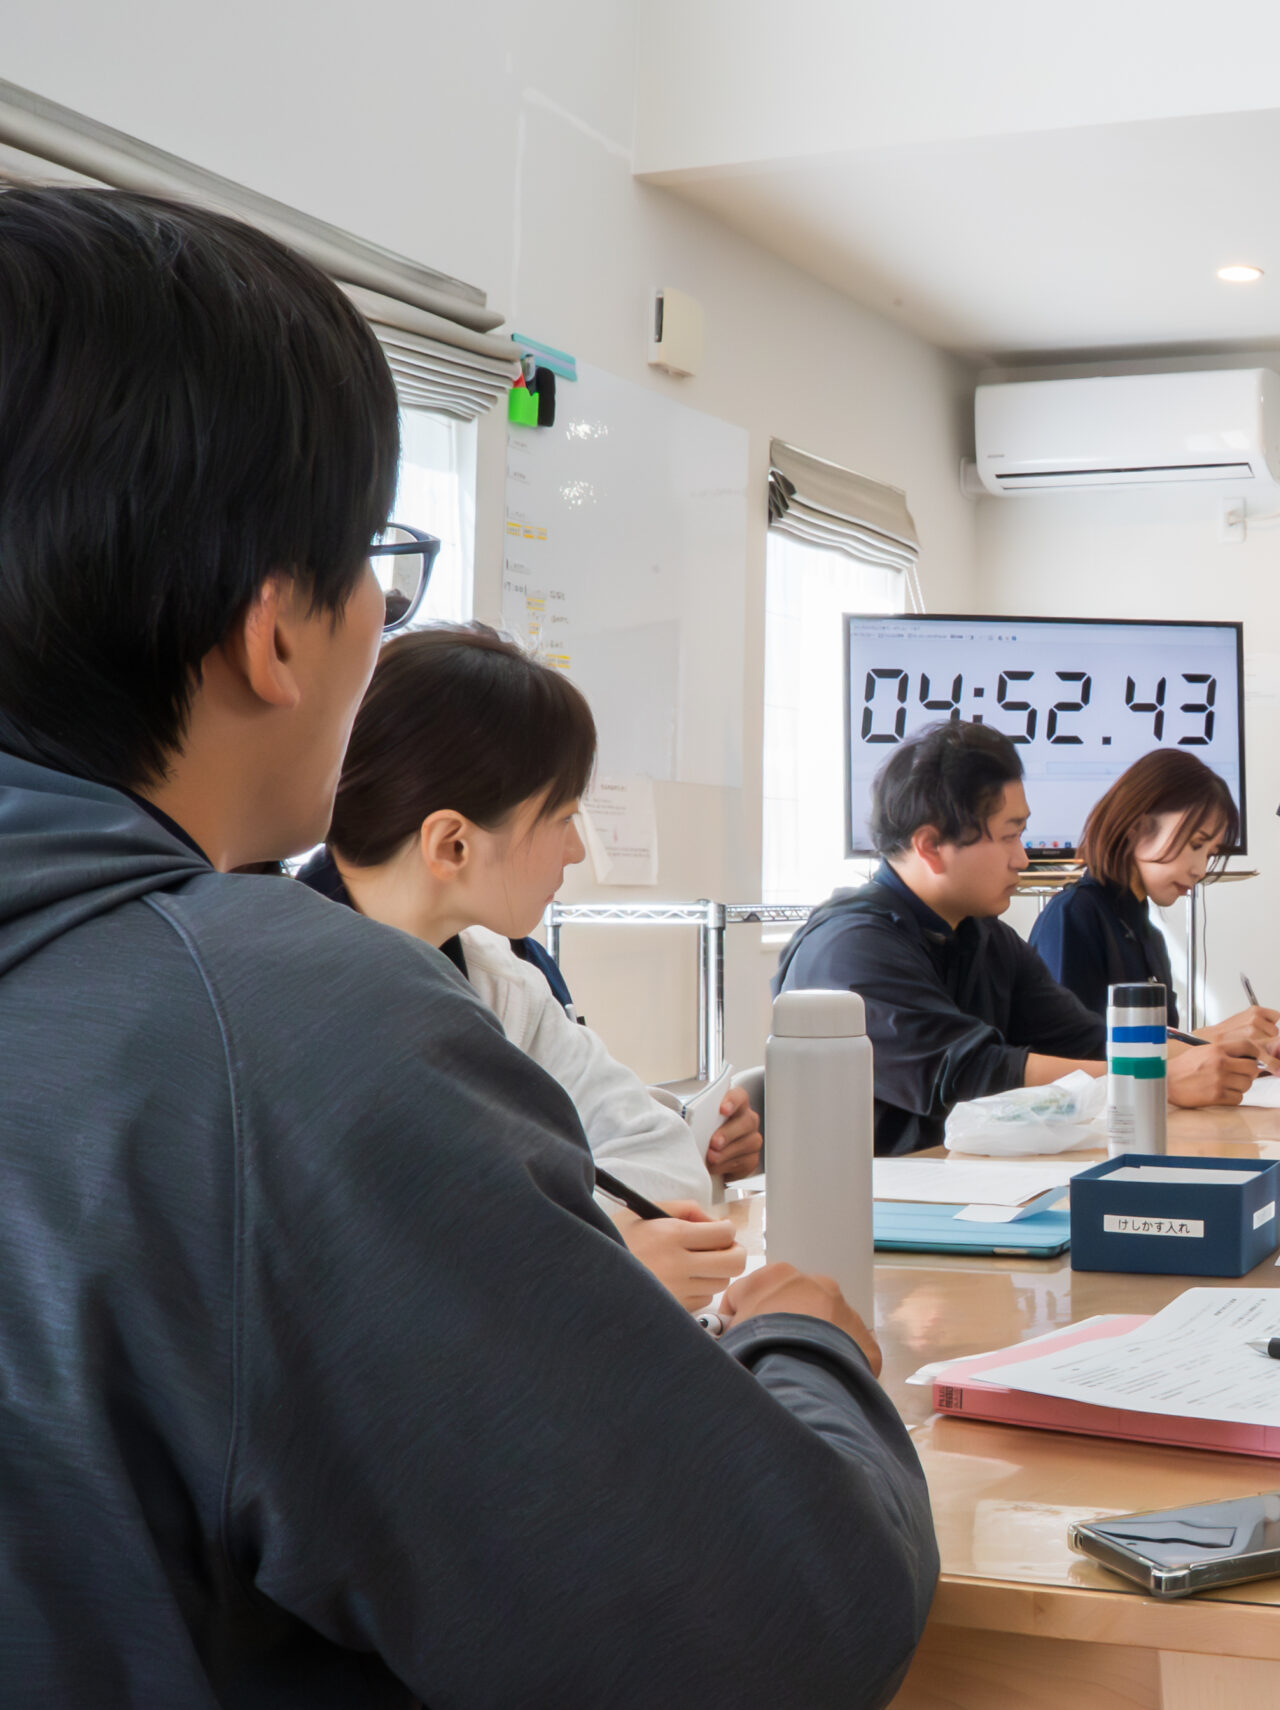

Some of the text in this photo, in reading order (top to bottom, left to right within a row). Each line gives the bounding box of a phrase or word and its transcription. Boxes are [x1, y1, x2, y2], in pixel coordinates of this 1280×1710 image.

[1118, 1219, 1190, 1234] けしかす入れ
